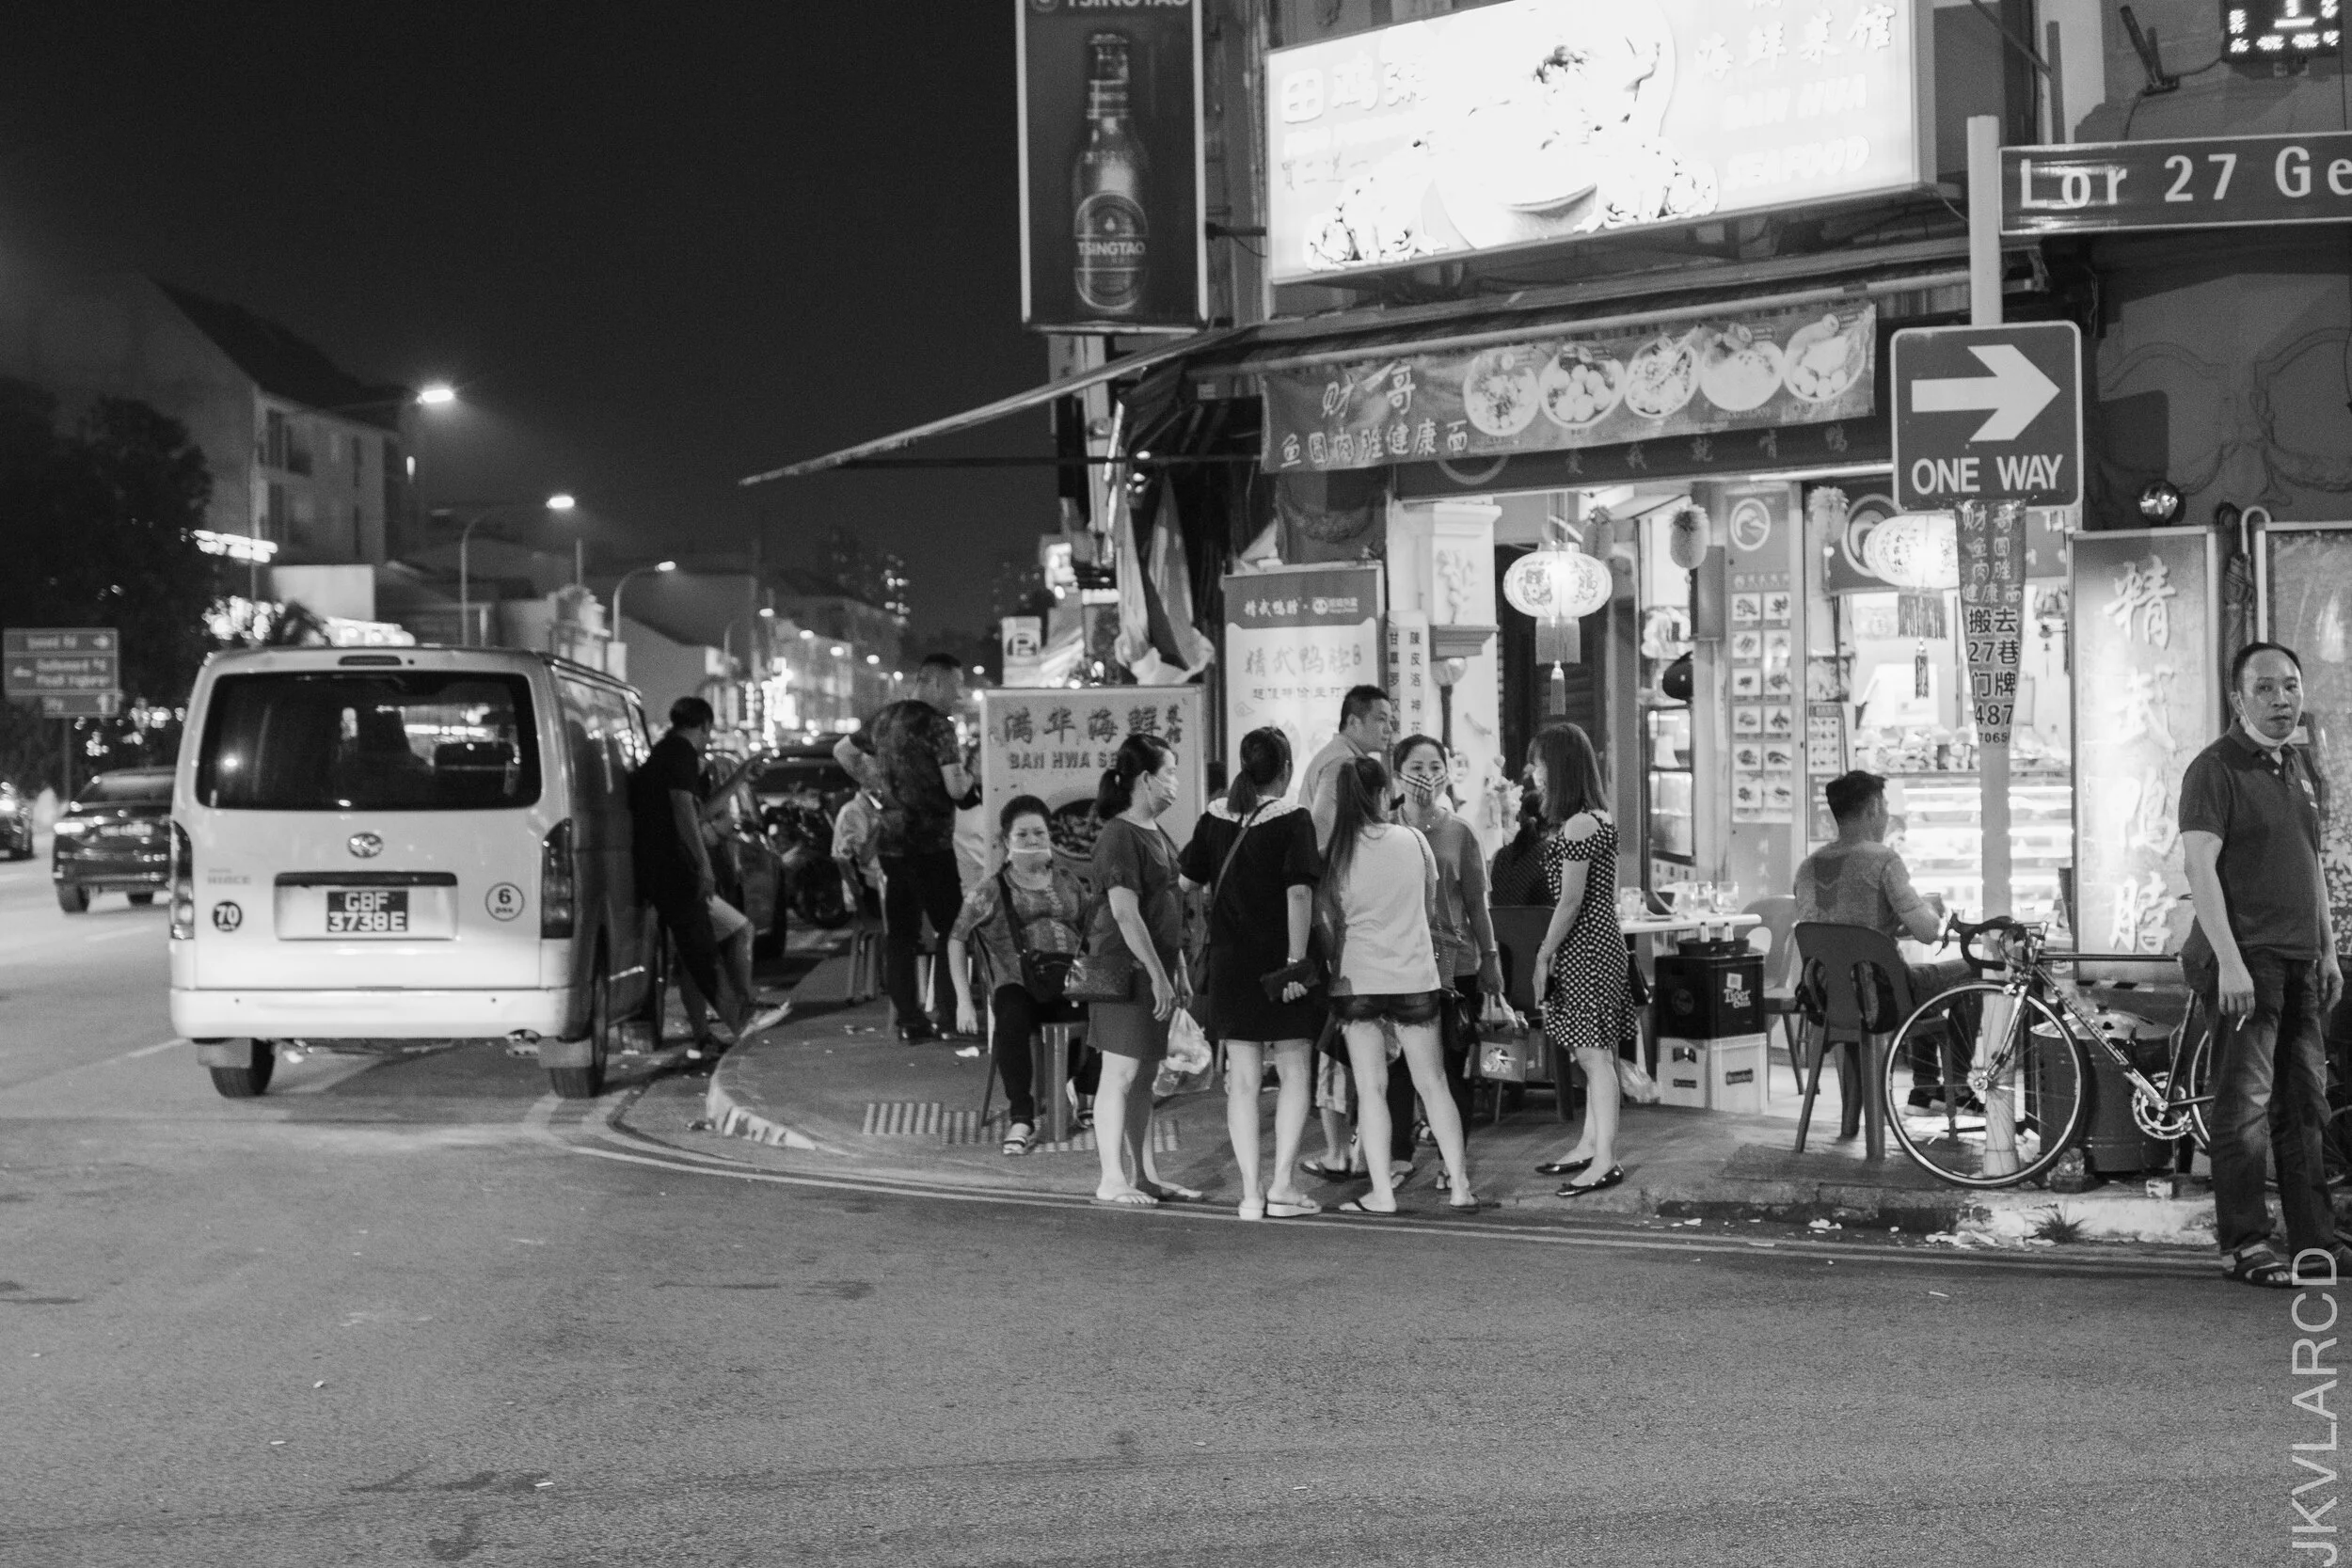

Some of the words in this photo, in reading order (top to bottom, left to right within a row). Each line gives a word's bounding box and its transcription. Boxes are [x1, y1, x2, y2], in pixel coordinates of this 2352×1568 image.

[1721, 135, 1869, 190] SEAFOOD
[2020, 158, 2127, 209] Lor
[2164, 154, 2237, 202] 27
[2275, 146, 2352, 198] Ge
[1077, 241, 1146, 255] TSINGTAO
[1321, 363, 1415, 419] 财哥
[1912, 457, 1980, 496] ONE
[1995, 453, 2064, 492] WAY
[1968, 609, 2017, 635] 搬去
[1968, 641, 2018, 665] 27巷
[1972, 673, 2015, 697] 门牌
[1975, 704, 2013, 725] 487
[1007, 751, 1042, 768] BAN
[1051, 750, 1089, 768] HWA
[344, 892, 389, 911] GBF
[499, 888, 511, 904] 6
[215, 904, 239, 925] 70
[327, 911, 406, 932] 3738E
